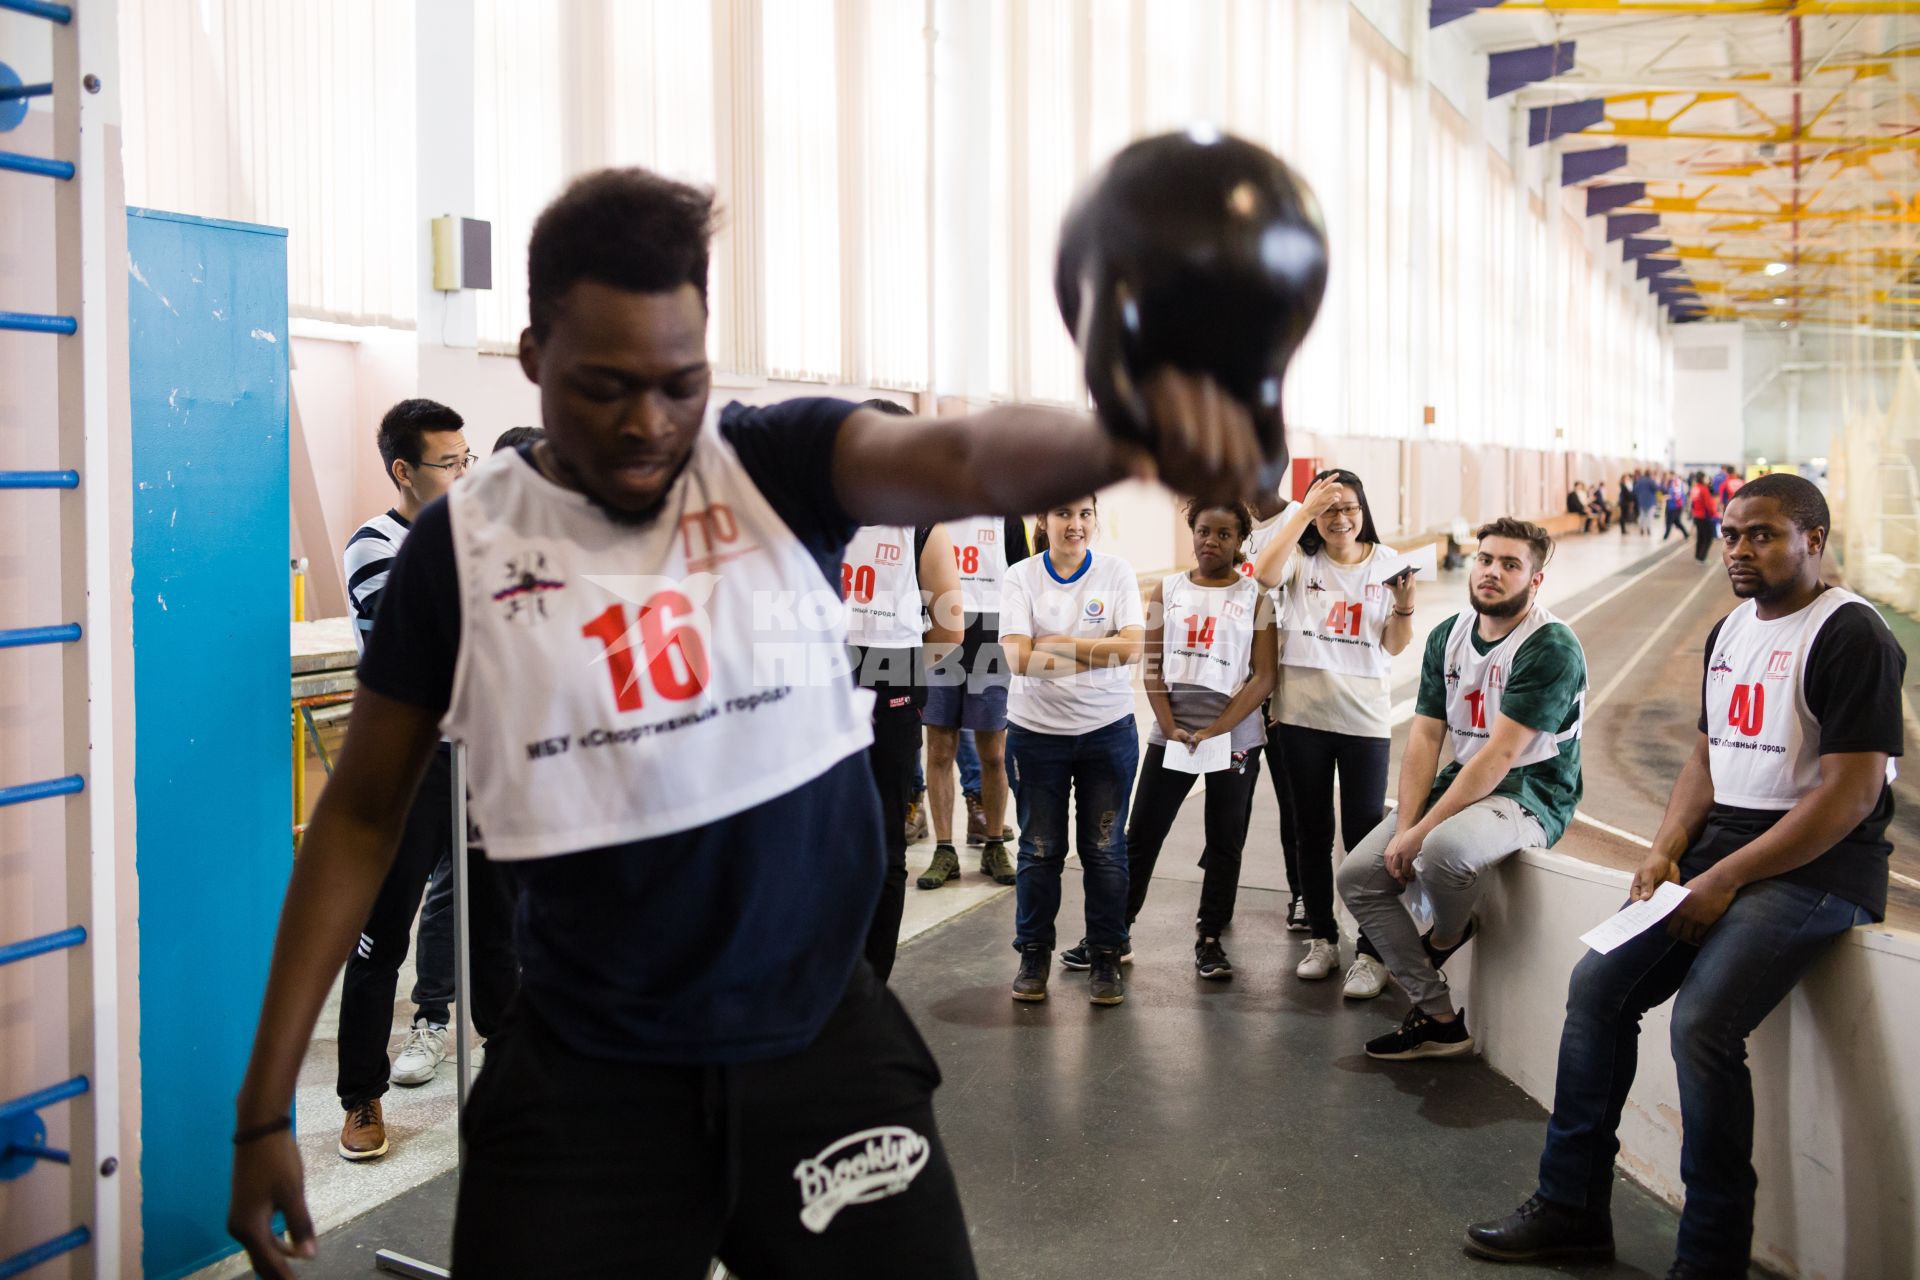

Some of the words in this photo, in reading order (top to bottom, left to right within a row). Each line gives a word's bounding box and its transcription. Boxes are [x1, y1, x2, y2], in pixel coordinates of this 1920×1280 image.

[875, 543, 901, 561] ГТО
[953, 545, 979, 574] 8
[1183, 614, 1217, 650] 14
[1326, 601, 1363, 635] 41
[581, 589, 712, 714] 16
[1728, 682, 1764, 737] 40
[1759, 743, 1787, 755] город»
[793, 1131, 925, 1205] Brooklyn
